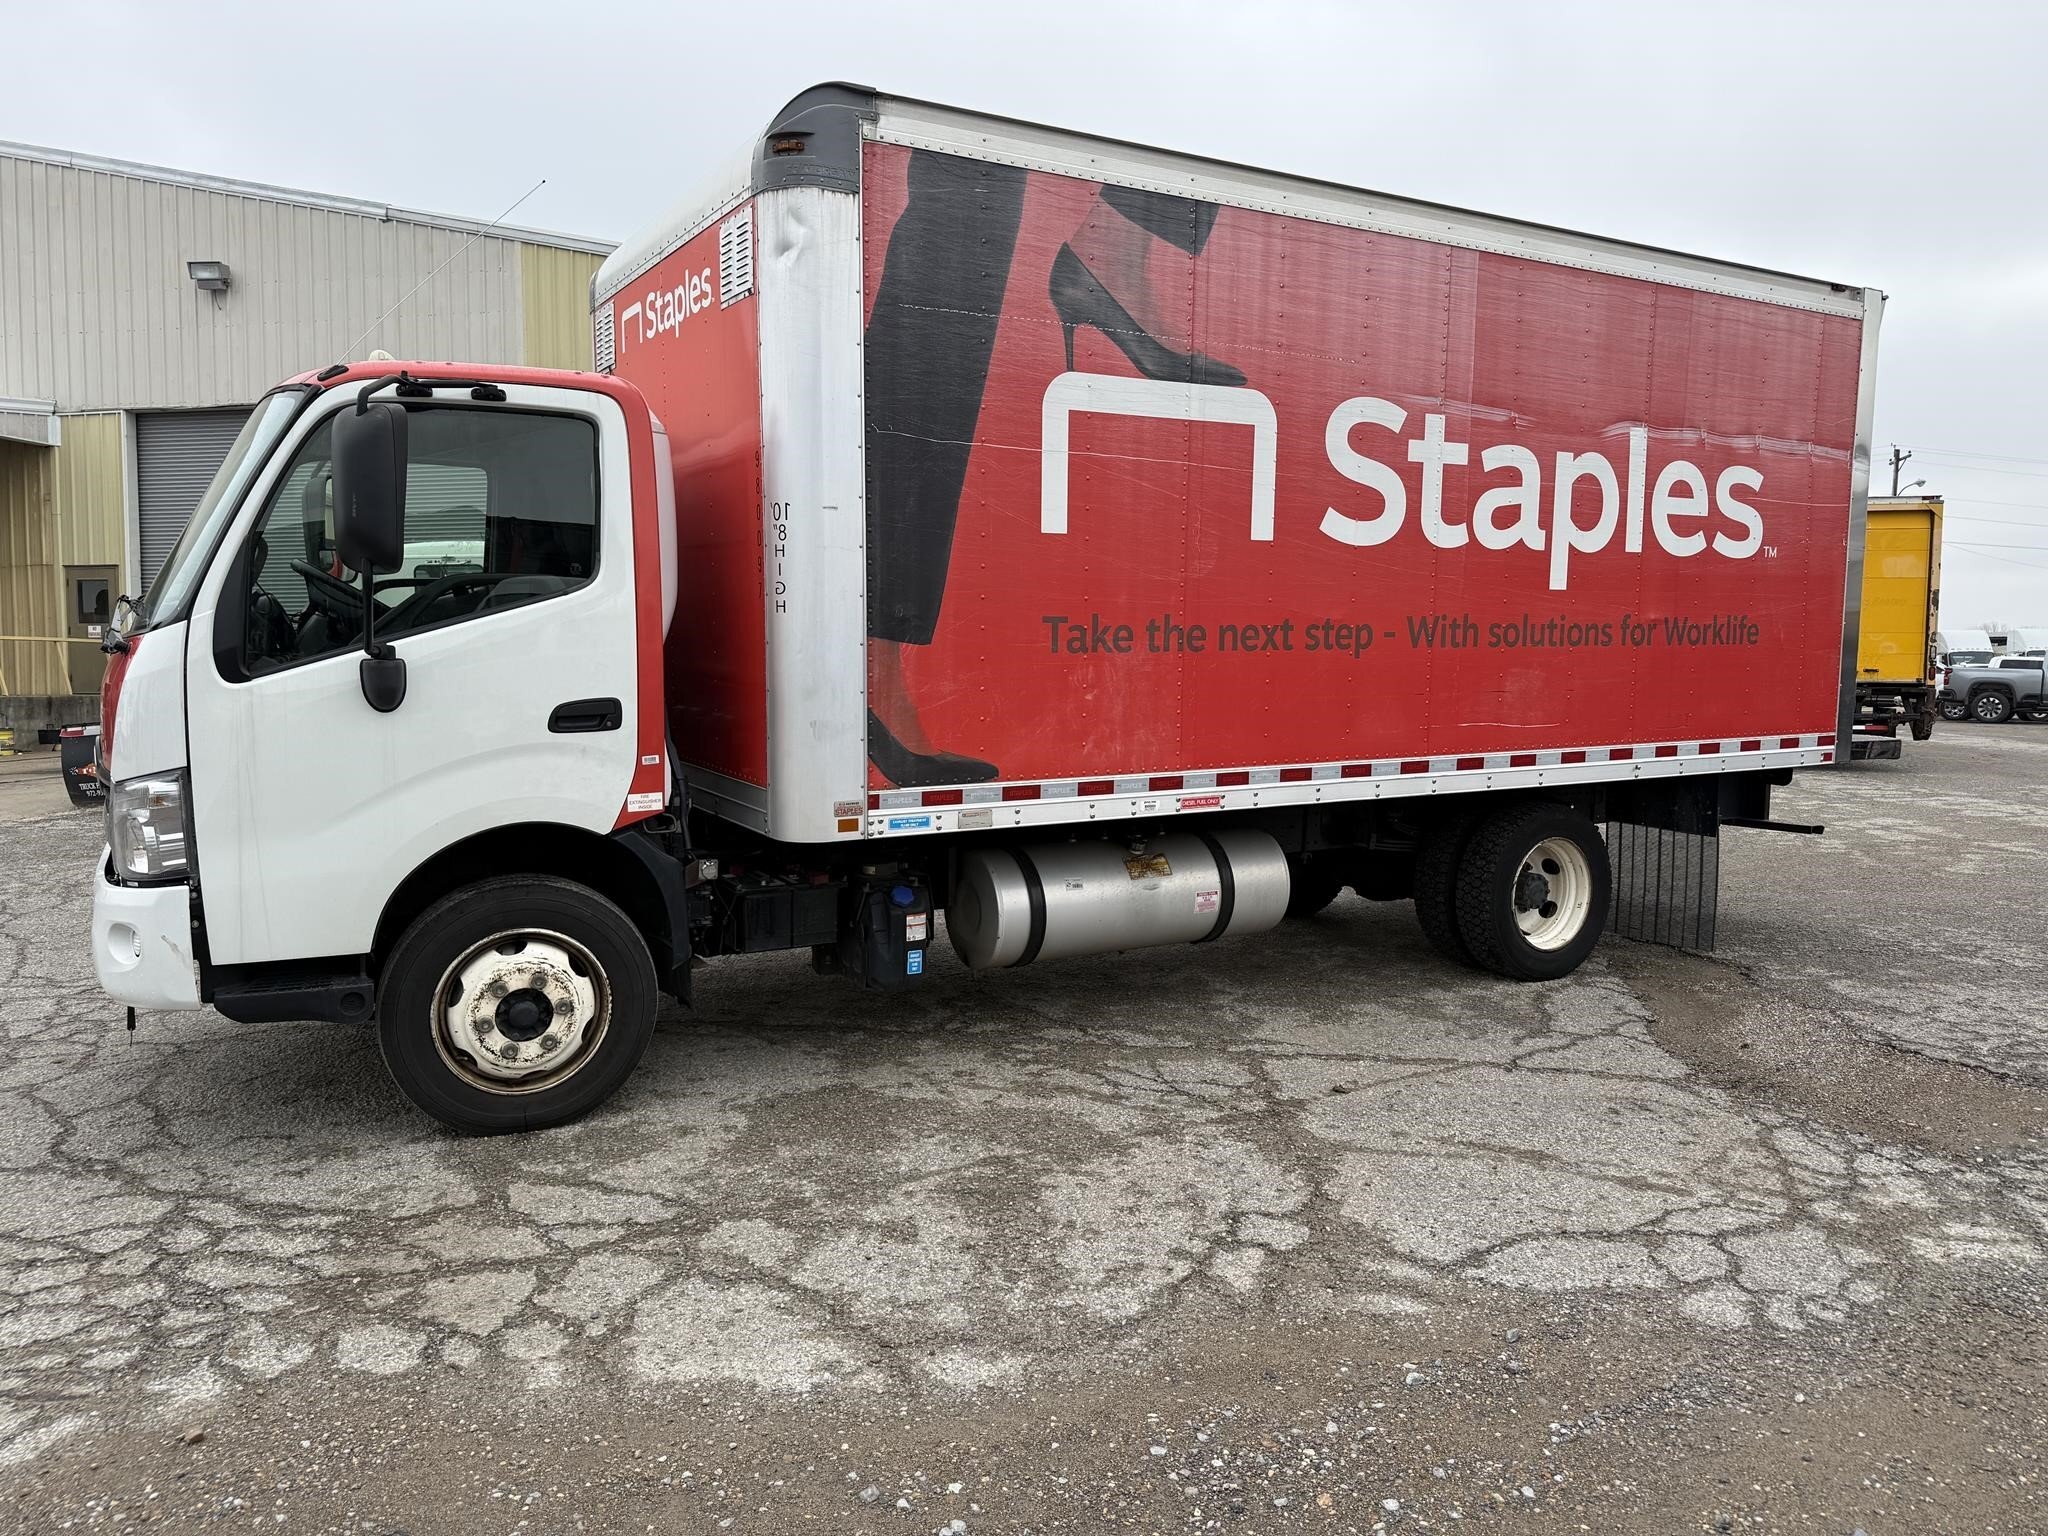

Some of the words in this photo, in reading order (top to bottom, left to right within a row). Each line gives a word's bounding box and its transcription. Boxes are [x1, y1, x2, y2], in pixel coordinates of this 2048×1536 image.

[646, 267, 712, 339] Staples
[1319, 396, 1764, 591] Staples
[1763, 546, 1777, 558] TM
[1042, 614, 1133, 654] Take
[1146, 614, 1207, 653] the
[1218, 618, 1294, 652] next
[1305, 618, 1373, 659] step
[1407, 614, 1479, 648] With
[1488, 614, 1613, 648] solutions
[1620, 614, 1657, 647] for
[1664, 615, 1760, 646] Worklife
